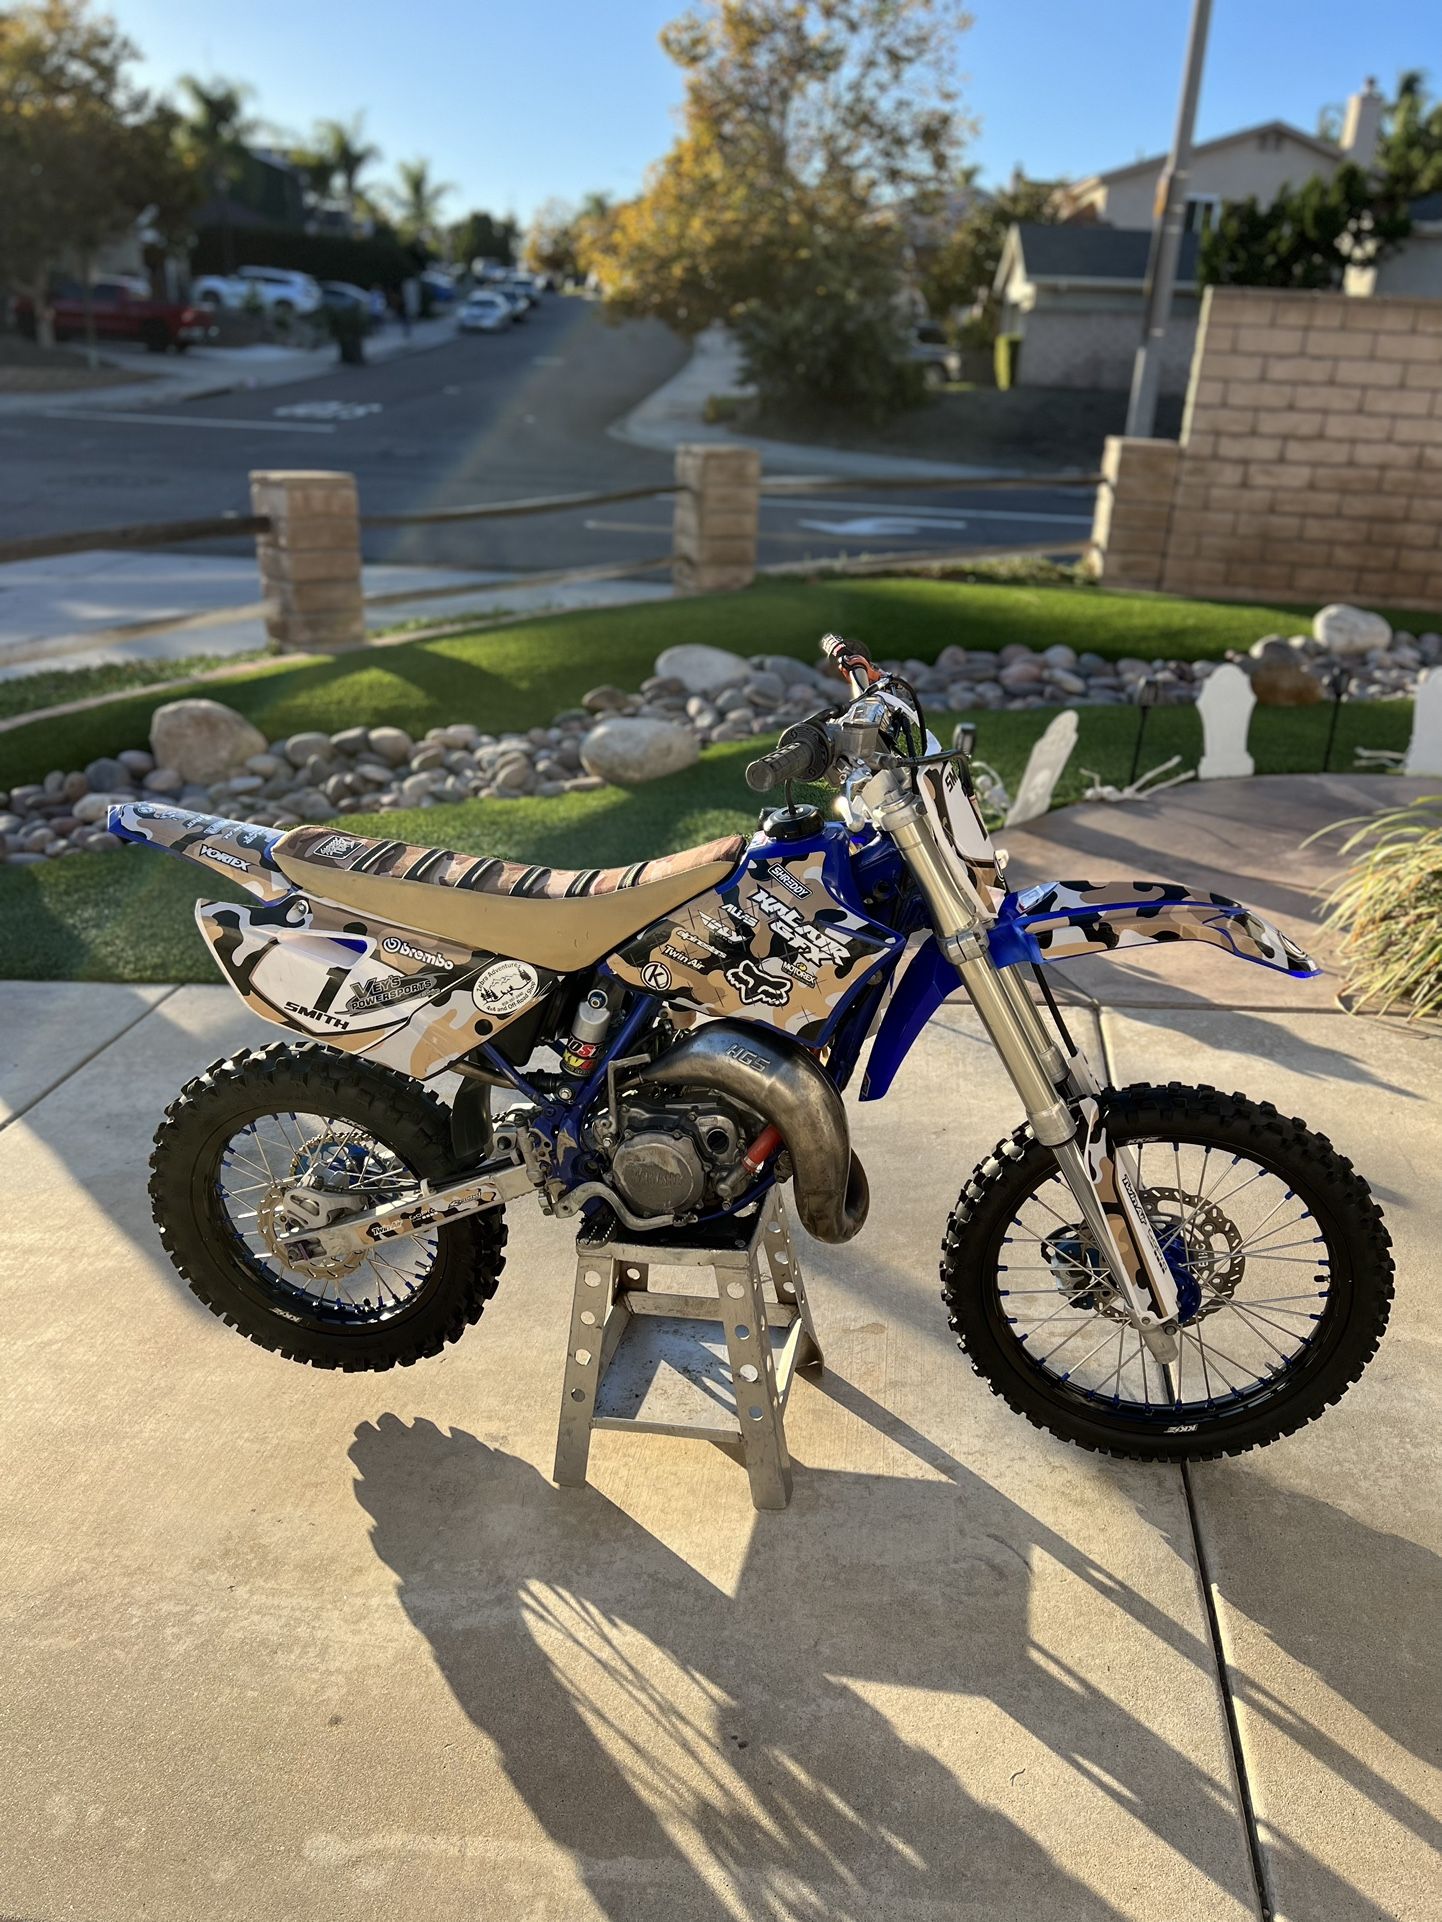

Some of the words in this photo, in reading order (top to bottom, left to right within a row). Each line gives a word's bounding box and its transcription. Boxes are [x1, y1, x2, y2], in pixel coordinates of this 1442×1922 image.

[200, 846, 250, 873] VORTEX
[771, 867, 809, 899] SHREDDY
[400, 941, 454, 971] brembo
[664, 944, 688, 963] Twin
[687, 957, 705, 970] Air
[769, 920, 832, 966] GFX
[783, 961, 816, 983] MOTOREX
[313, 967, 353, 1013] 1
[351, 980, 432, 1010] POWERSPORTS
[284, 1001, 349, 1030] SMITH
[726, 1043, 770, 1072] HGS
